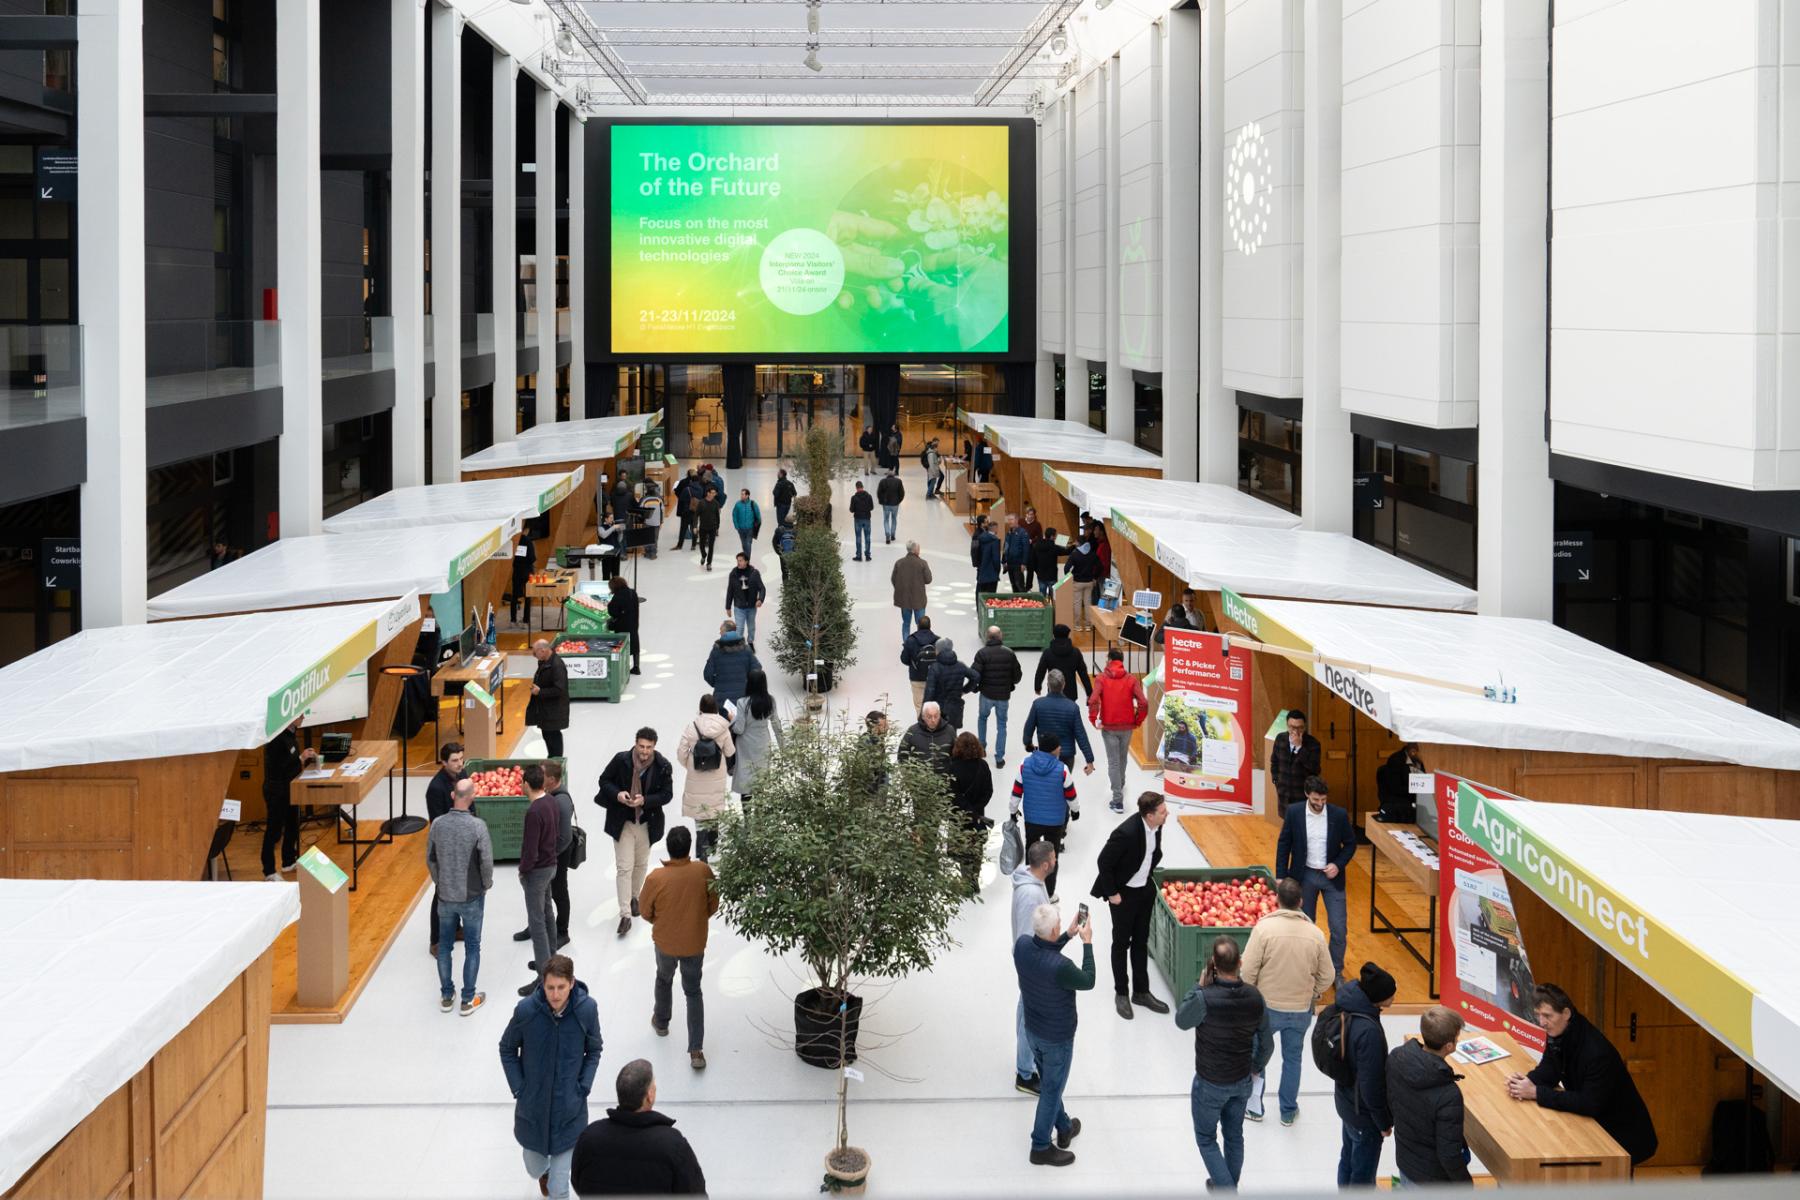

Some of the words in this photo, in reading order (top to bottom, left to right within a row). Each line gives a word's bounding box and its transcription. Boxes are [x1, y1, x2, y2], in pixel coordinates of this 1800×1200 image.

[639, 152, 681, 172] The
[688, 152, 779, 172] Orchard
[639, 177, 662, 197] of
[668, 177, 703, 197] the
[711, 177, 781, 197] Future
[640, 217, 681, 230] Focus
[686, 219, 704, 230] on
[708, 217, 729, 230] the
[734, 217, 768, 230] most
[640, 234, 710, 246] innovative
[715, 233, 757, 249] digital
[640, 250, 730, 264] technologies
[640, 310, 736, 322] 21-23/11/2024
[50, 557, 81, 565] Coworki
[1226, 594, 1258, 634] Hectre
[1172, 636, 1202, 649] hectre
[1172, 657, 1184, 666] QC
[1185, 659, 1191, 667] &
[1192, 659, 1216, 670] Picker
[1172, 666, 1221, 679] Performance
[280, 664, 331, 718] Optiflux
[1448, 846, 1476, 859] Automated
[1472, 799, 1649, 959] Agriconnect
[1469, 1004, 1496, 1022] Sample
[1511, 1025, 1545, 1047] Accuracy
